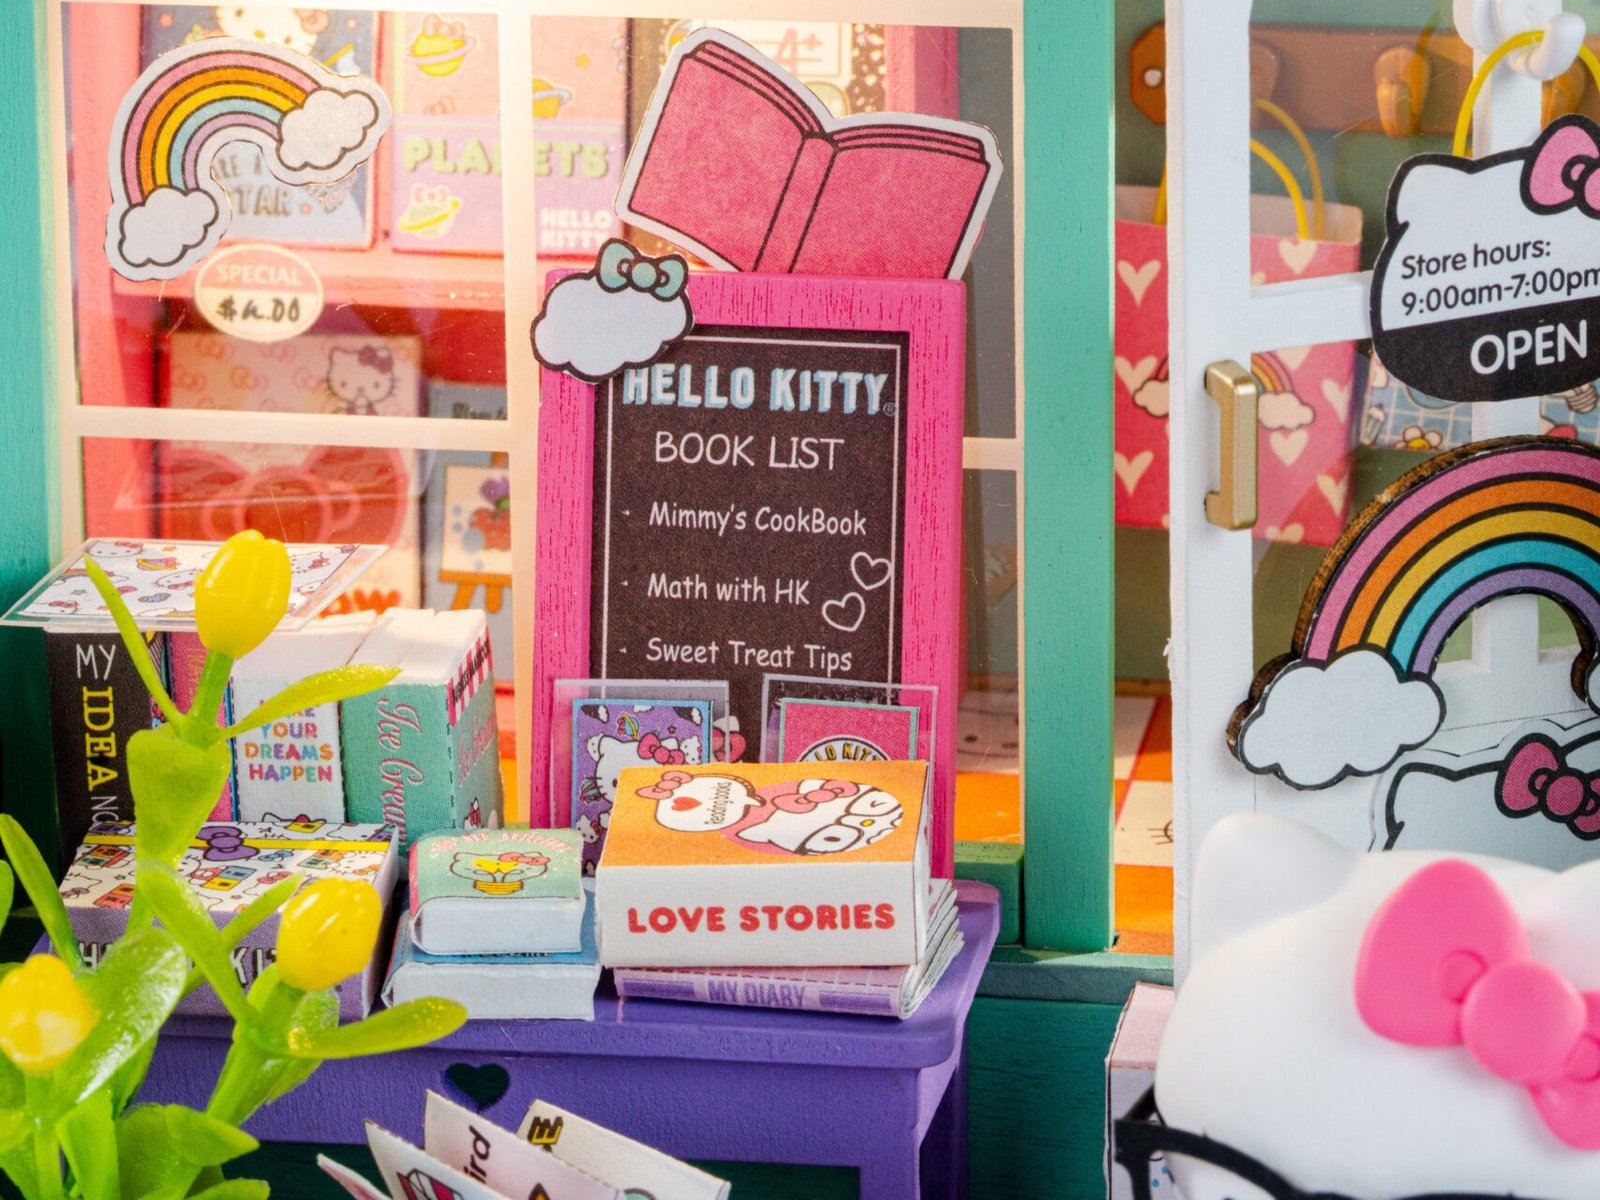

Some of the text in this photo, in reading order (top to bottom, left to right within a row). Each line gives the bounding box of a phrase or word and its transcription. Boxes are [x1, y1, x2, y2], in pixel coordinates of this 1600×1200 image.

[402, 136, 611, 179] PLAETS
[540, 207, 613, 231] HELLO
[216, 263, 304, 285] SPECIAL
[1401, 240, 1551, 279] Store hours:
[1470, 319, 1587, 375] OPEN
[623, 363, 889, 416] HELLO KITTY
[655, 431, 845, 470] BOOK LIST
[649, 501, 867, 536] Mimmy's CookBook
[647, 573, 810, 605] Math with HK
[75, 643, 116, 681] MY
[646, 637, 853, 678] Sweet Treat Tips
[82, 686, 119, 792] IDEA
[260, 721, 318, 739] YOUR
[243, 742, 335, 762] DREAMS
[248, 762, 334, 783] HAPPEN
[627, 902, 896, 934] LOVE STORIES
[707, 979, 806, 1008] MY DIARY
